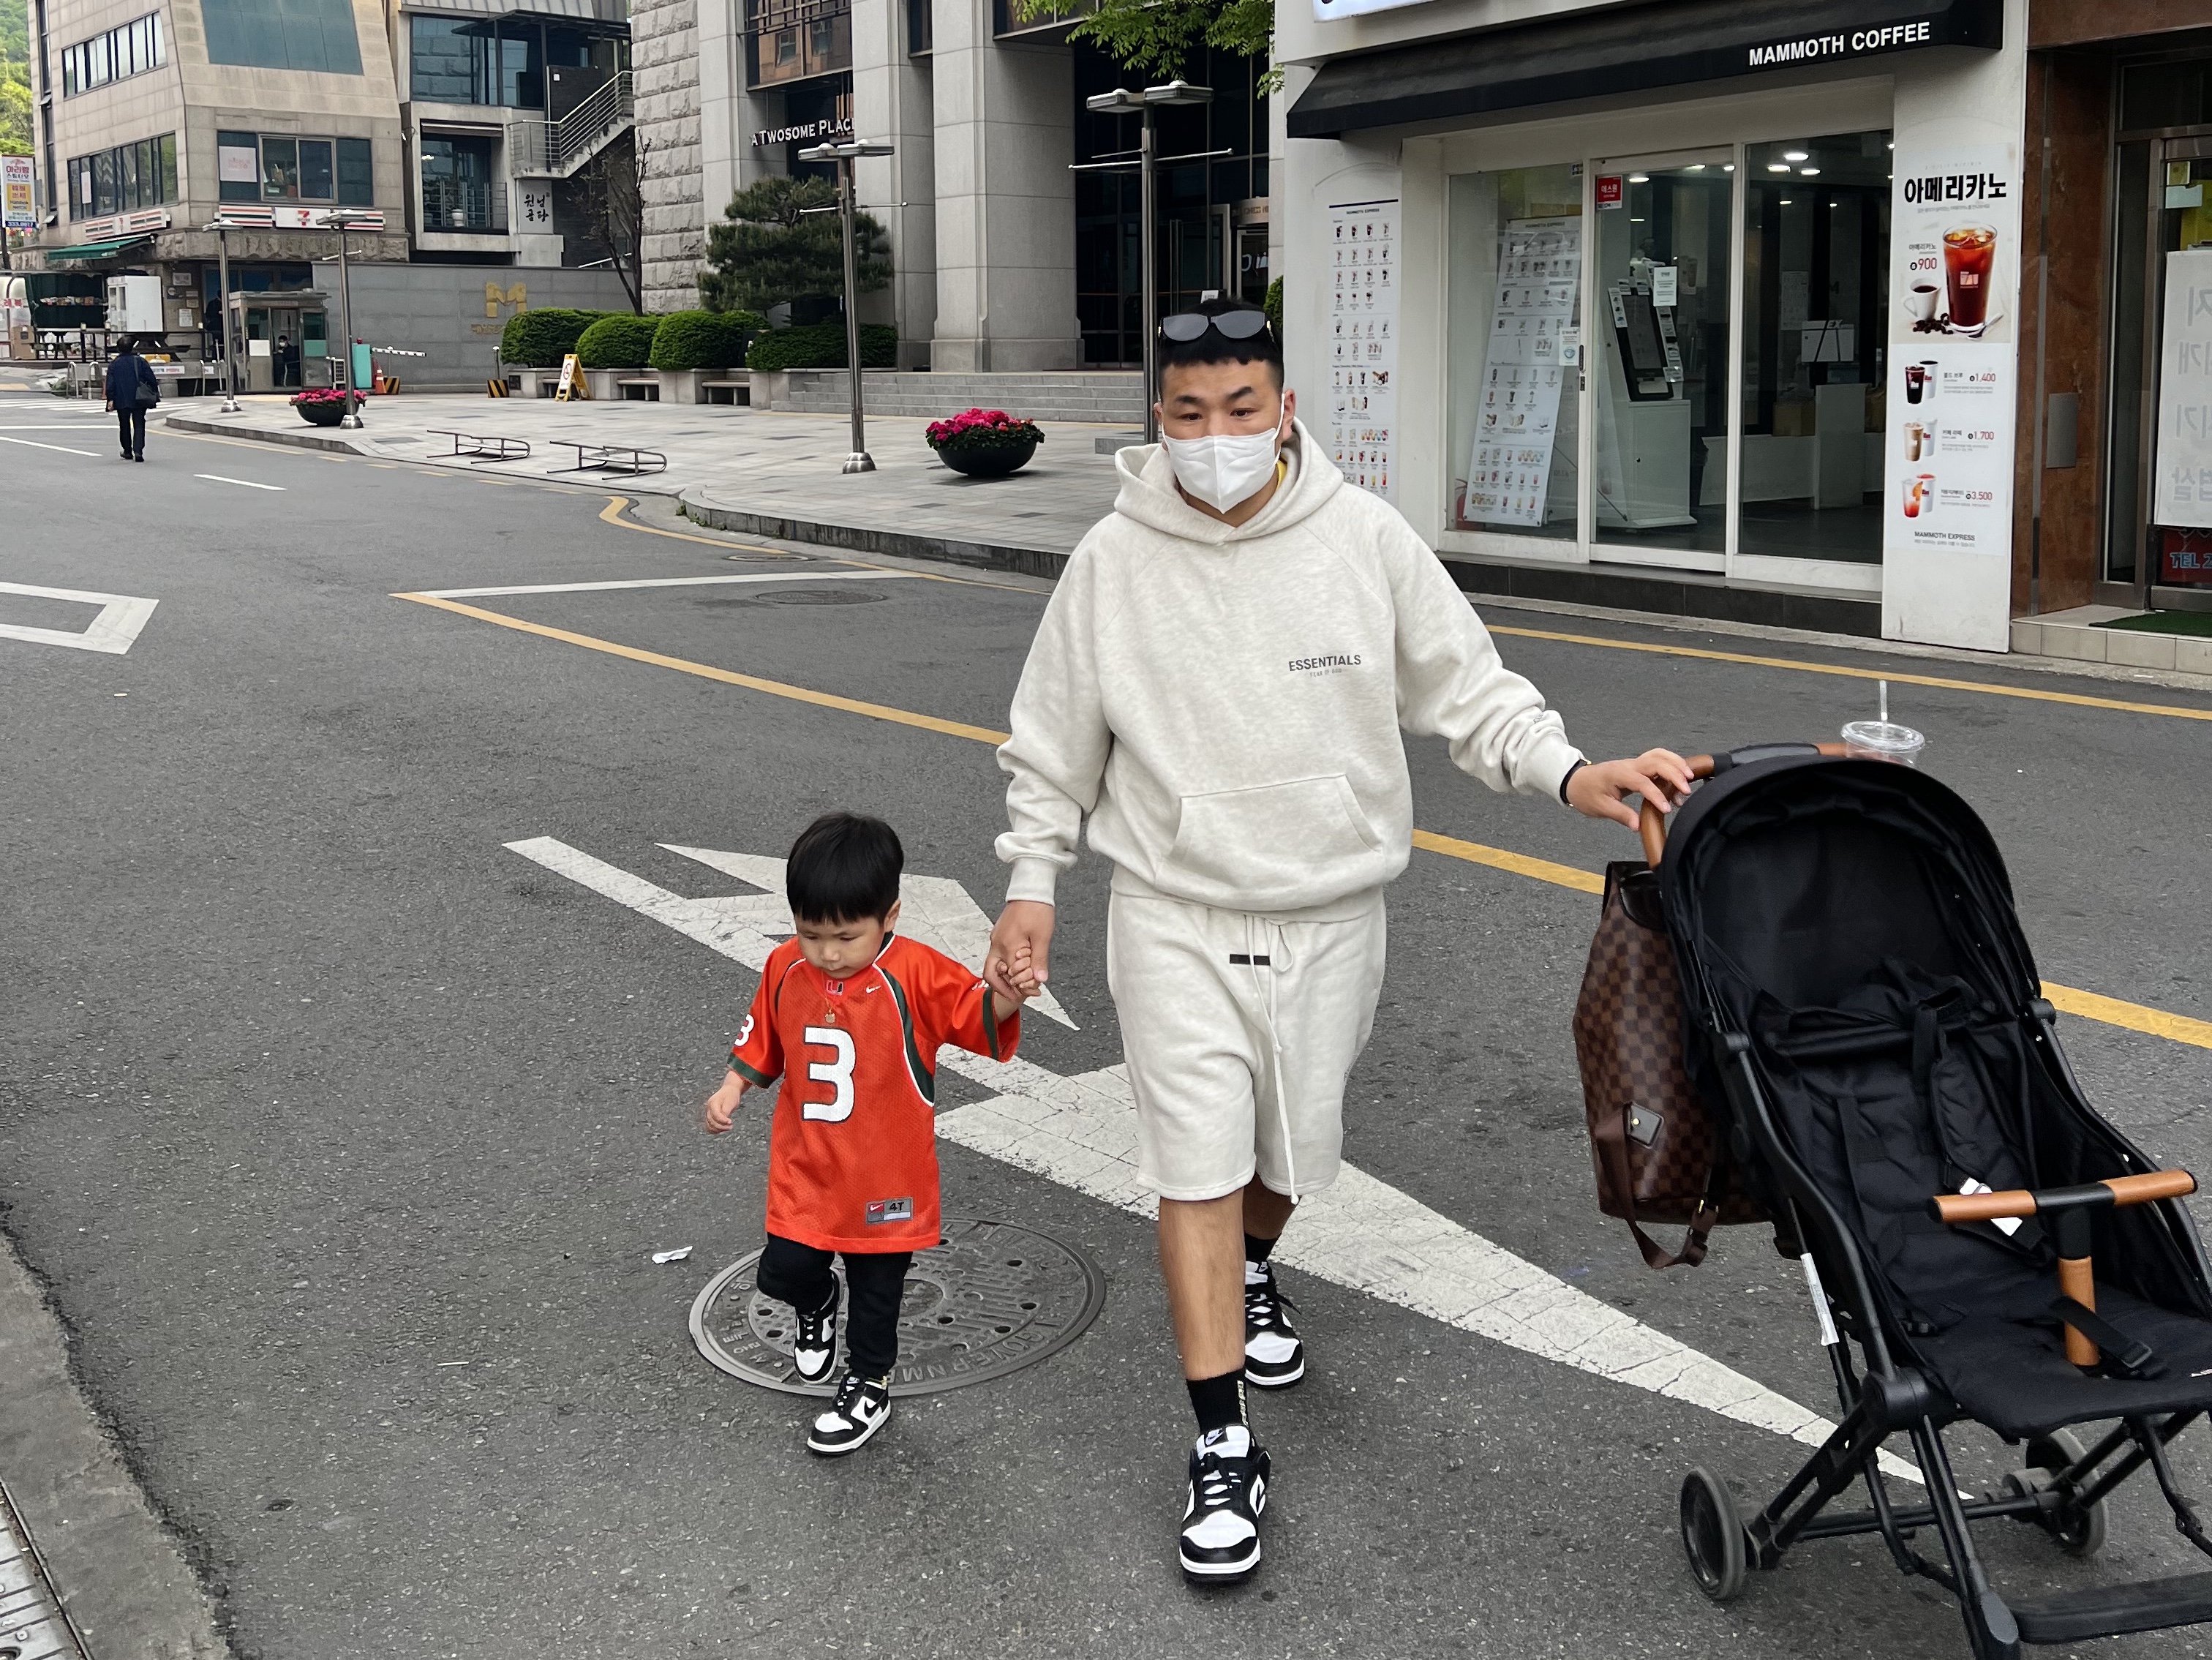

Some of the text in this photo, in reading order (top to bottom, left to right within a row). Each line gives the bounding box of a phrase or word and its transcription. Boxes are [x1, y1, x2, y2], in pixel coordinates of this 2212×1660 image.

[1748, 20, 1930, 67] MAMMOTH COFFEE
[750, 133, 759, 146] A
[759, 123, 816, 145] TWOSOME
[1904, 173, 2007, 204] 아메리카노
[1918, 258, 1938, 270] 900
[1975, 372, 1996, 383] 1,400
[1971, 490, 1993, 500] 3,500
[1914, 530, 1976, 541] MAMMOTH EXPRESS
[2169, 552, 2201, 569] TEL
[1288, 654, 1361, 672] ESSENTIALS
[802, 1026, 857, 1124] 3
[889, 1201, 905, 1212] 4T
